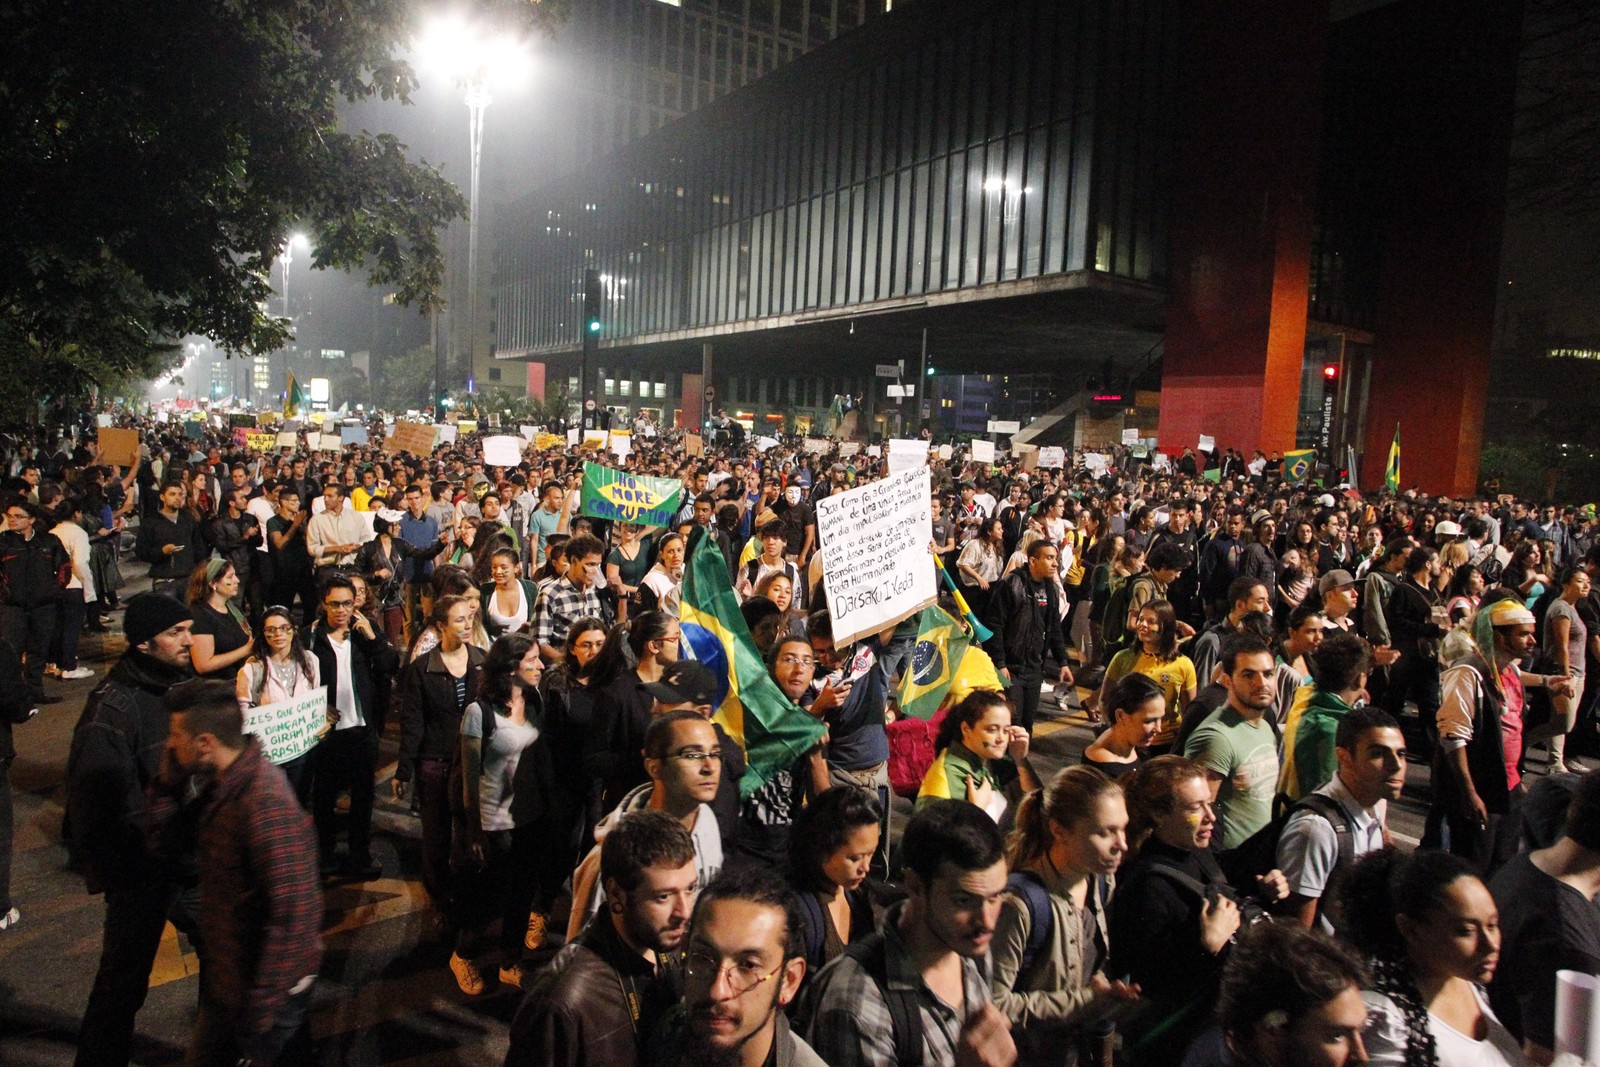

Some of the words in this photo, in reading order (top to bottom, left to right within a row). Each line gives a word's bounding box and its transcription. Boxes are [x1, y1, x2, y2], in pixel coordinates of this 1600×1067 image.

[1322, 397, 1332, 433] Paulista
[612, 487, 654, 504] MORE
[589, 499, 671, 525] CORRUPTION
[850, 506, 859, 519] de
[277, 707, 293, 718] QUE
[297, 696, 325, 713] CANTAM
[265, 716, 306, 735] DANÇAM
[311, 708, 319, 719] E
[270, 727, 304, 745] GIRAM
[306, 714, 325, 734] PARA
